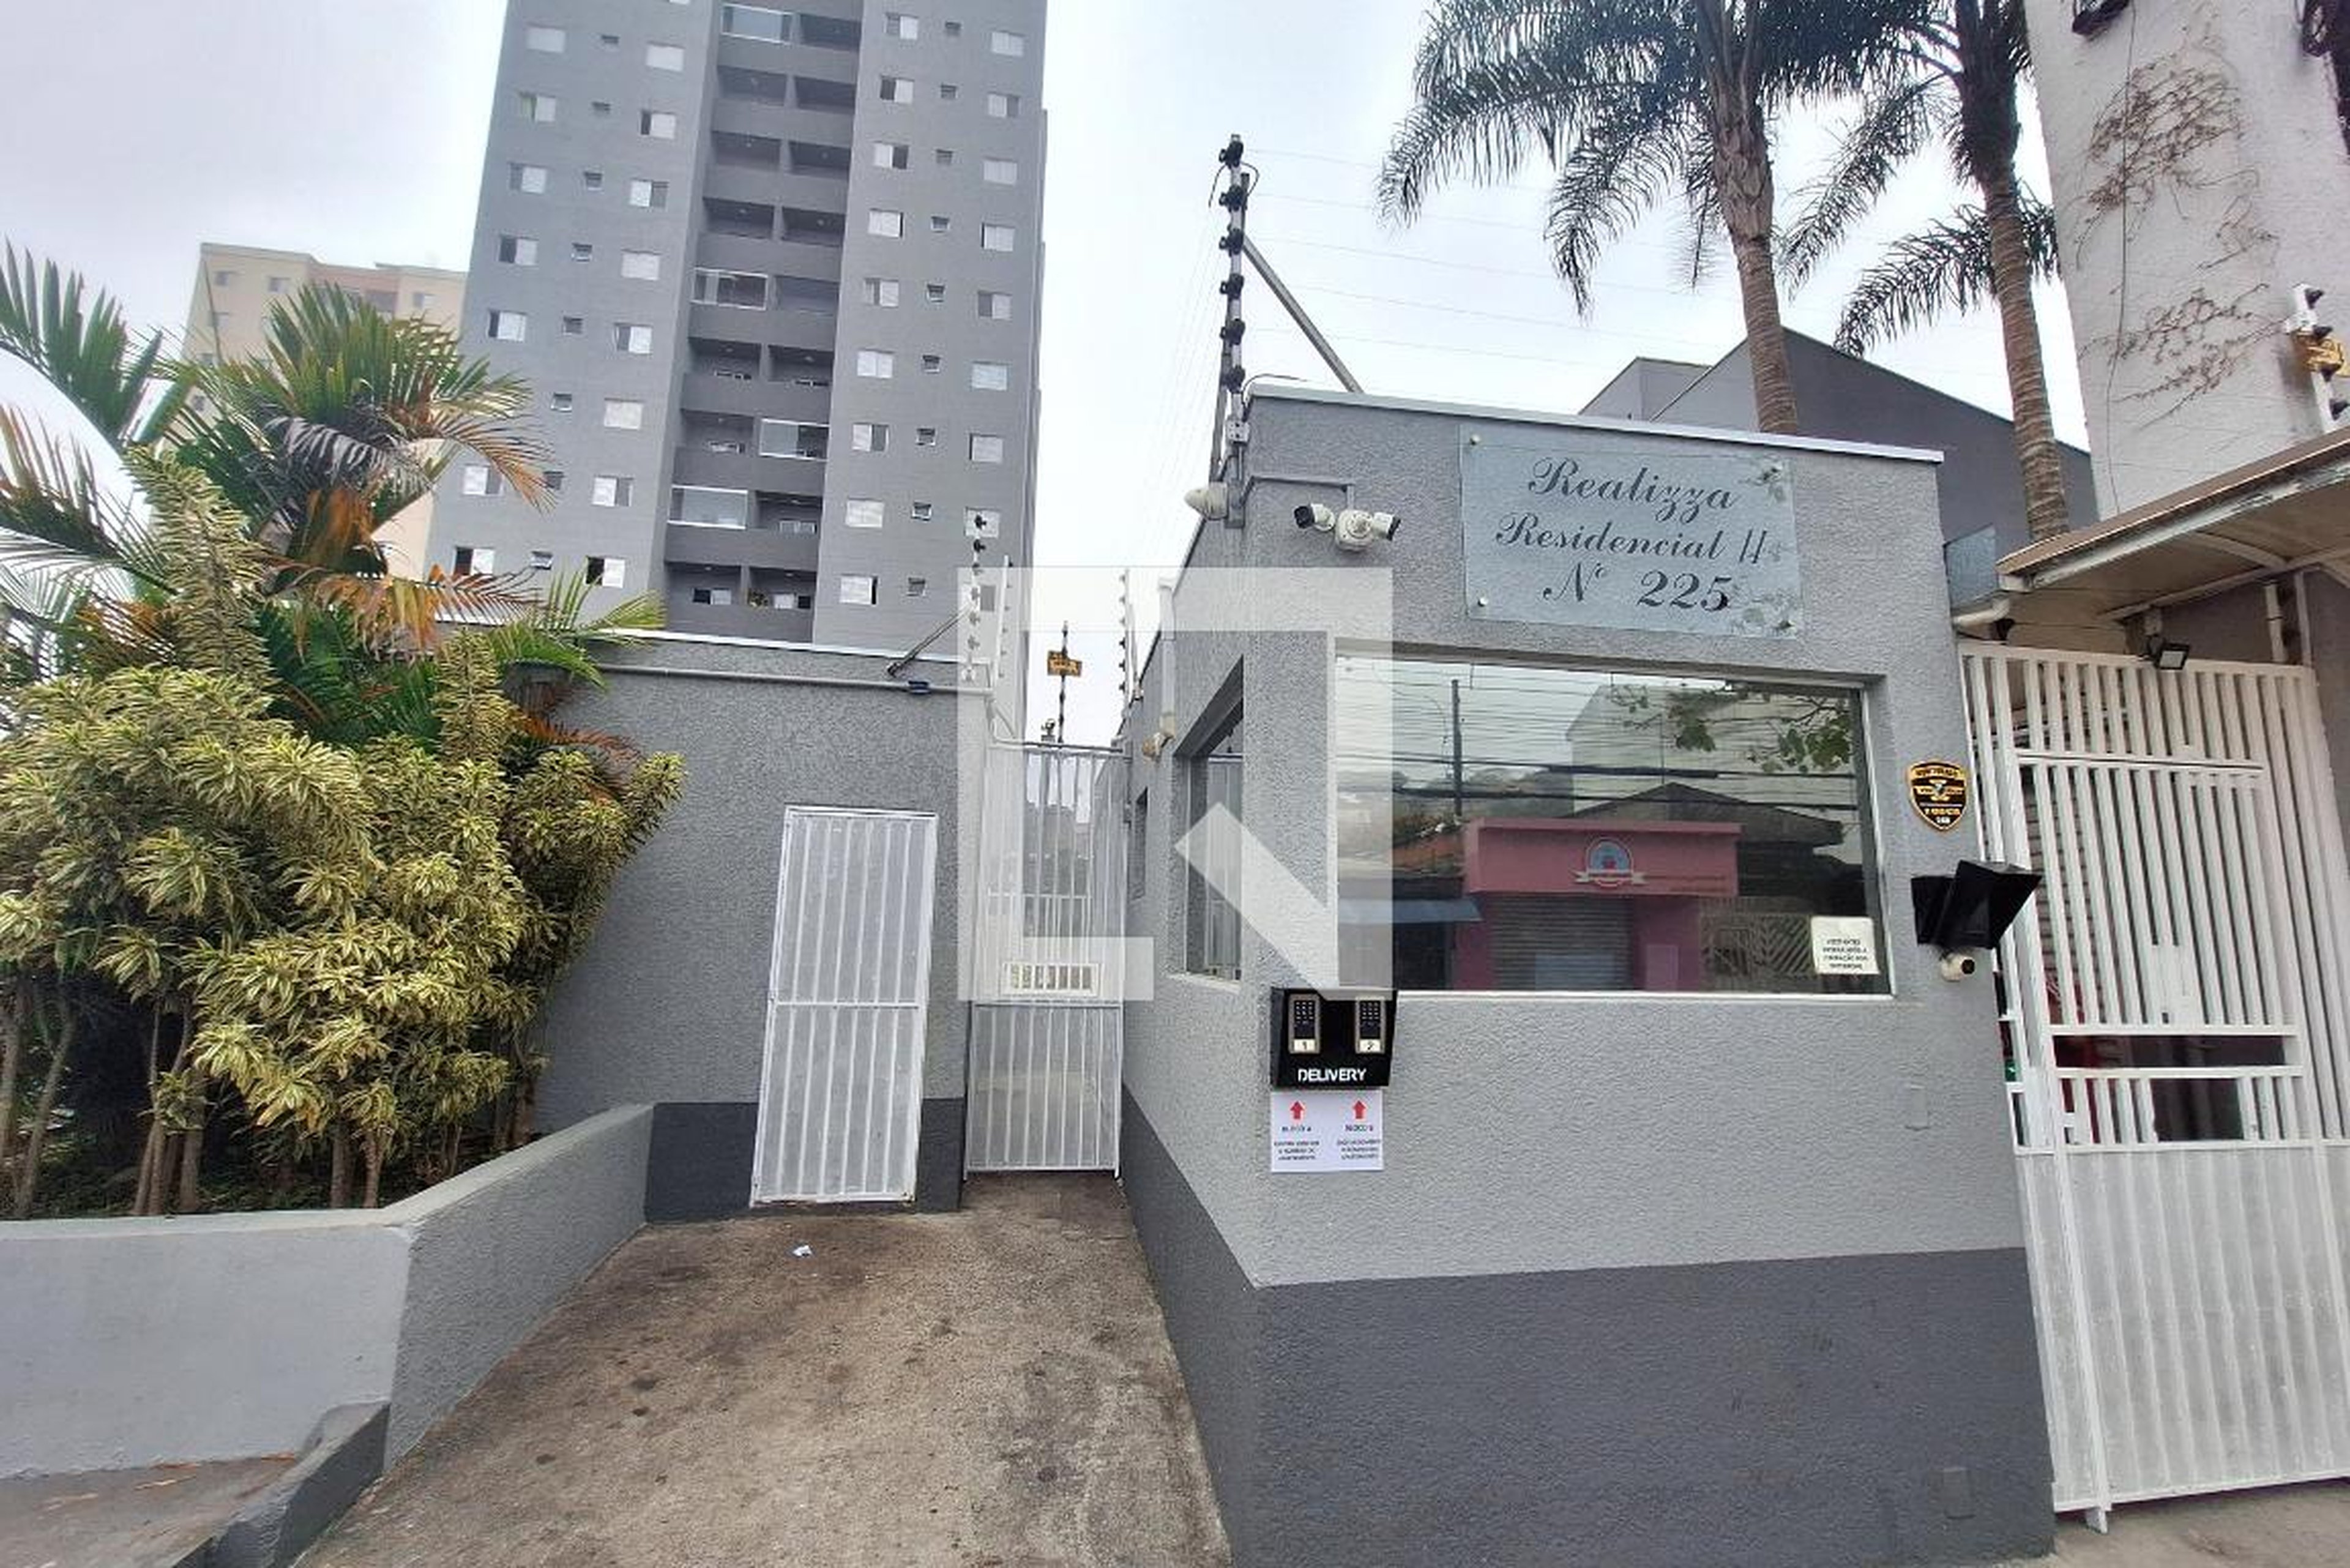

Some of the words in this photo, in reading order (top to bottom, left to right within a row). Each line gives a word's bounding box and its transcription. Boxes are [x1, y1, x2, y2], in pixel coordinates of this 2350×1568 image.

[1528, 457, 1739, 523] Realizza
[1496, 512, 1726, 559] Residencial
[1636, 570, 1733, 612] 225
[1297, 1067, 1367, 1082] DELIVERY
